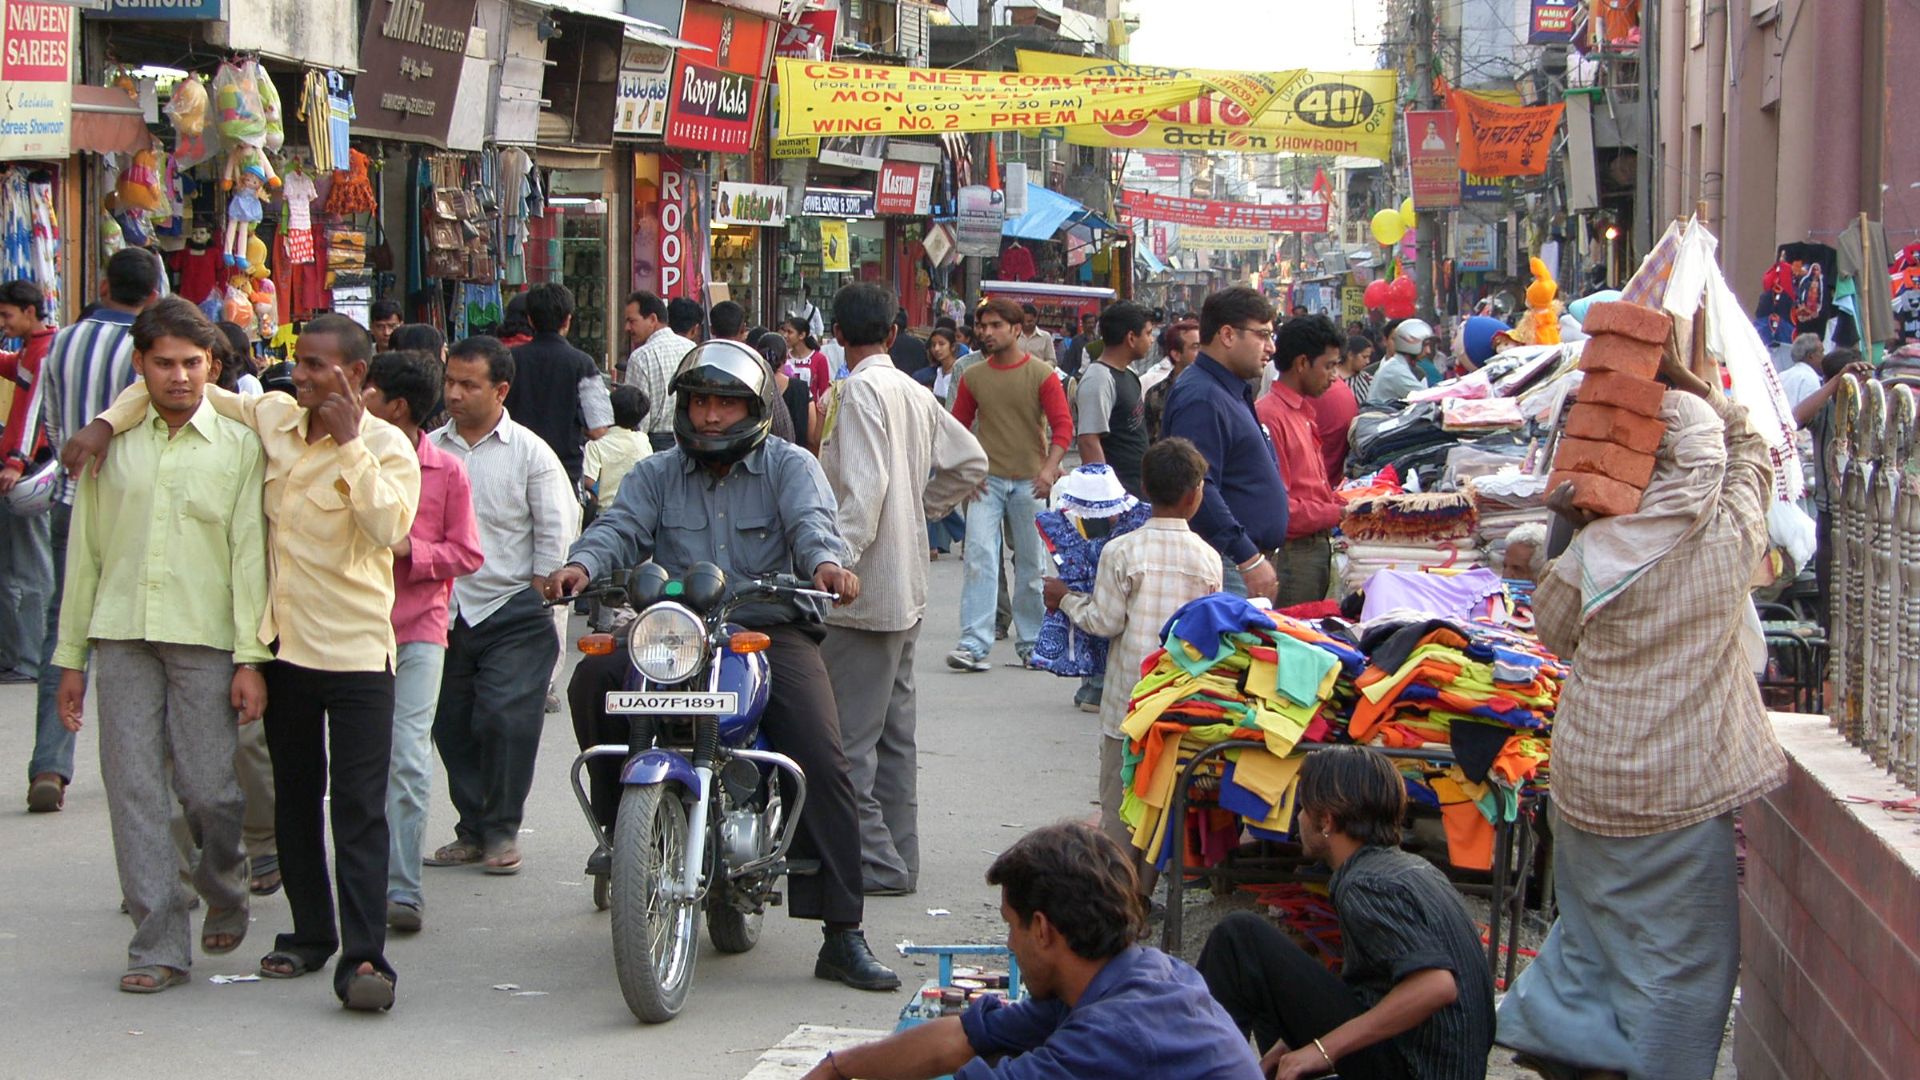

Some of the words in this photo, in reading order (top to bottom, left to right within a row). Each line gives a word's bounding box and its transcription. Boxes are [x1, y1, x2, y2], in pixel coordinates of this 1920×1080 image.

[8, 4, 68, 33] NAVEEN
[1538, 9, 1570, 18] FAMILY
[1541, 19, 1566, 29] WEAR
[6, 38, 67, 67] SAREES
[804, 64, 890, 81] CSIR
[909, 71, 987, 85] NET
[682, 66, 717, 116] Roop
[717, 76, 747, 115] Kala
[860, 82, 897, 90] LIFE
[831, 91, 902, 103] MON
[999, 100, 1040, 110] 7:30
[1050, 97, 1083, 109] PM)
[1299, 89, 1365, 125] 40%
[0, 118, 28, 135] Sarees
[813, 117, 882, 132] WING
[945, 115, 960, 128] 2
[991, 110, 1077, 126] PREM
[1364, 104, 1387, 133] OFF
[673, 121, 709, 141] SAREES
[721, 129, 747, 145] SUITS
[1164, 126, 1267, 148] action
[1275, 136, 1358, 152] SHOWROOM
[775, 146, 811, 157] casuals
[1153, 197, 1208, 214] NEW
[1220, 203, 1324, 221] TRENDS
[1215, 216, 1272, 228] SALE
[662, 172, 681, 295] ROOP
[619, 697, 725, 709] UA07F1891
